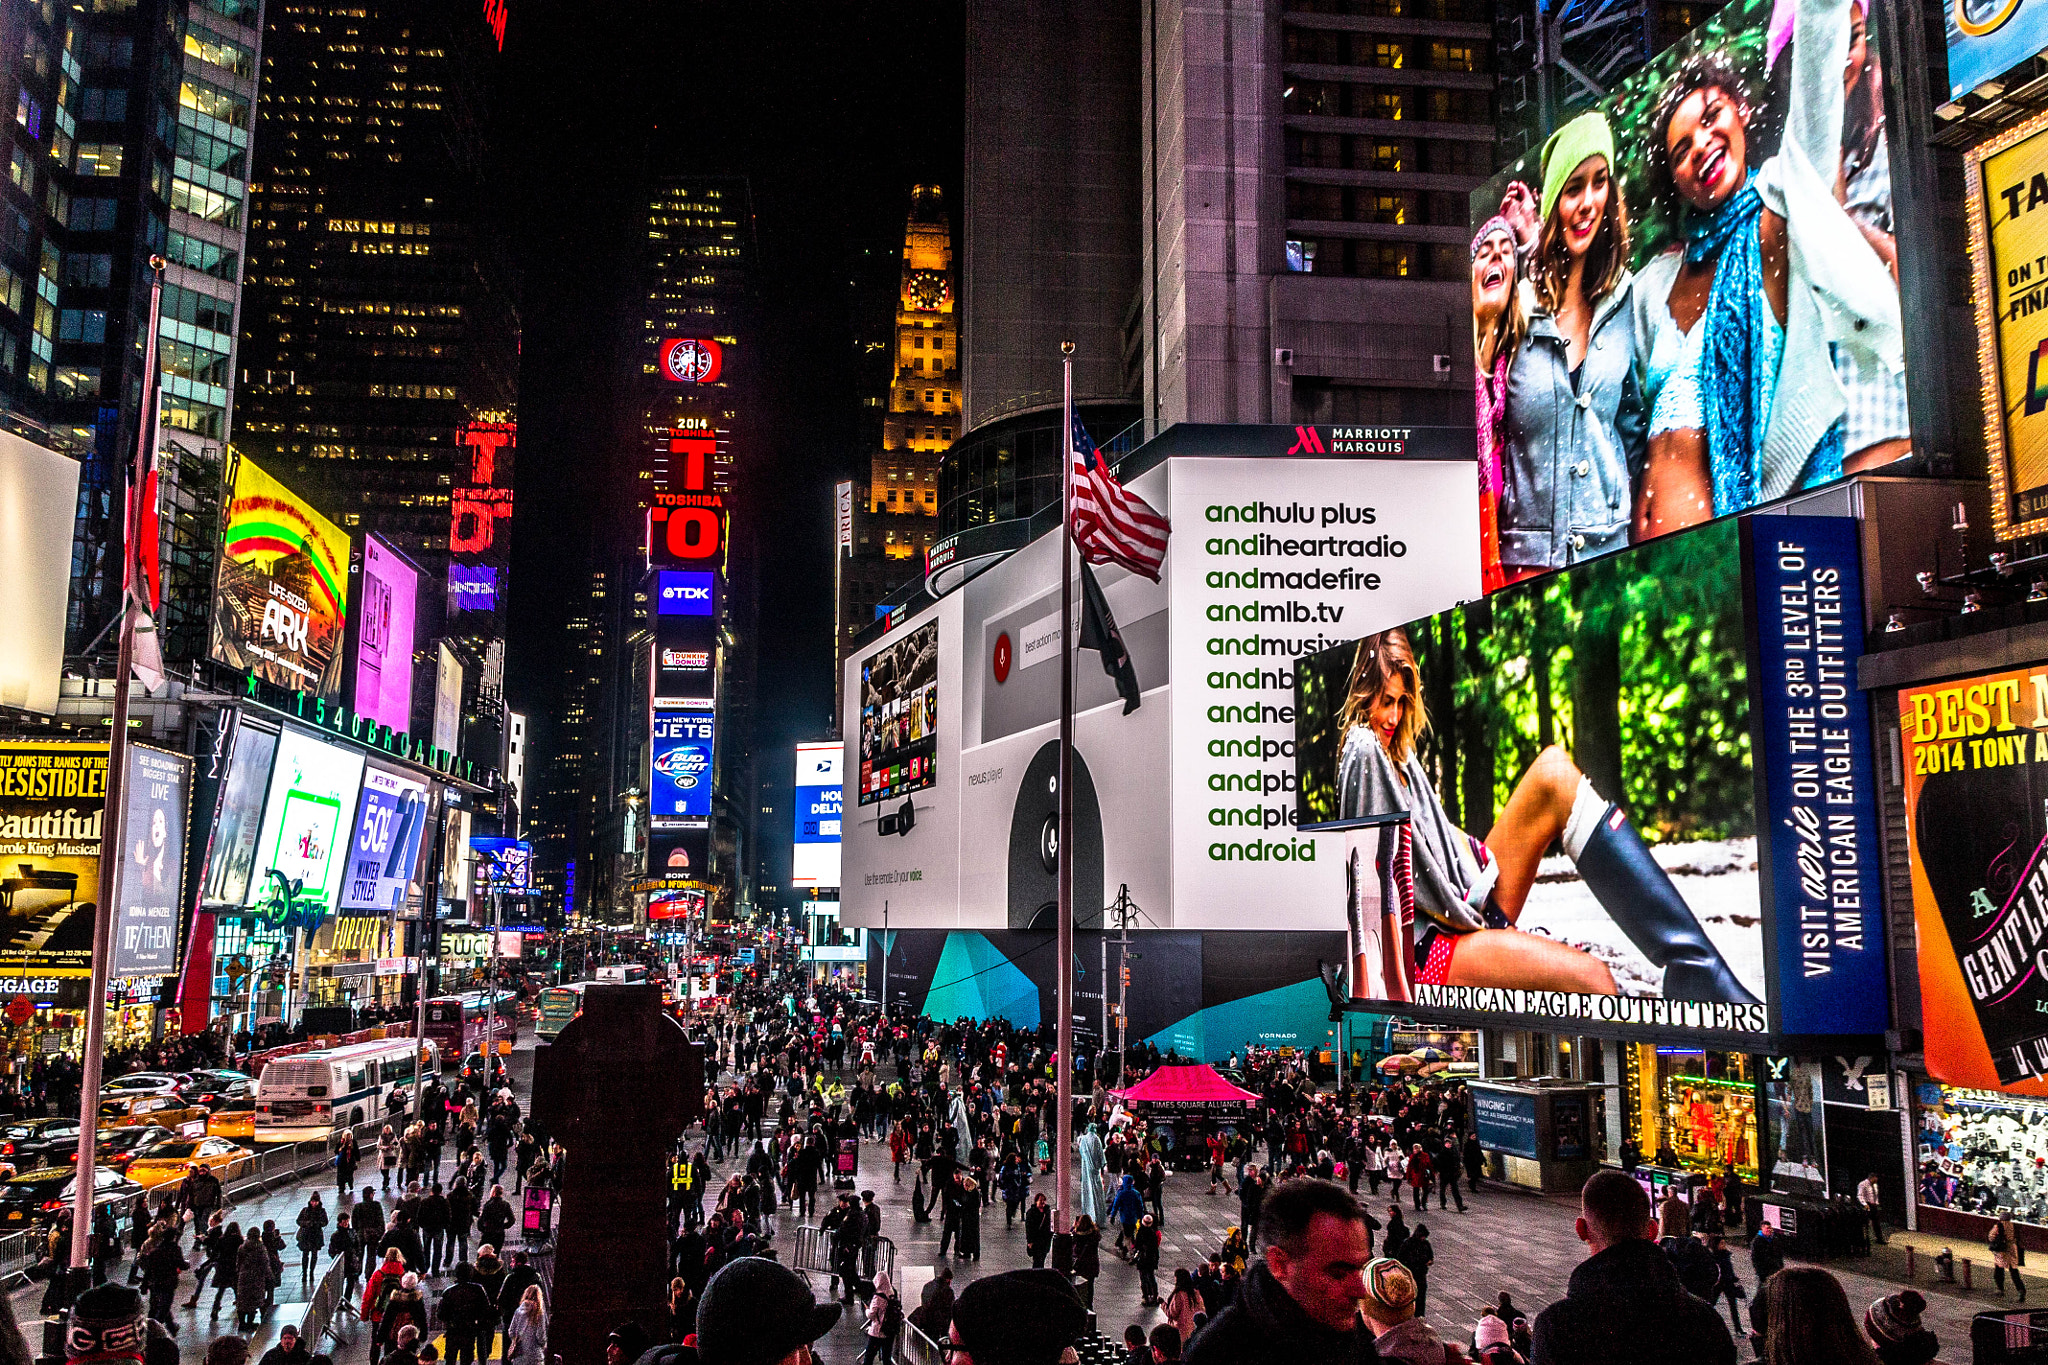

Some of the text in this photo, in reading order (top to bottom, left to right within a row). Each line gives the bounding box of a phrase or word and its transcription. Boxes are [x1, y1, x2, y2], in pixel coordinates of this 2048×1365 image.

[2008, 262, 2031, 287] ON
[670, 428, 715, 438] TOSHIBA
[677, 418, 708, 429] 2014
[1332, 428, 1411, 440] MARRIOTT
[1332, 441, 1403, 453] MARQUIS
[656, 494, 722, 507] TOSHIBA
[1205, 501, 1376, 528] andhulu plus
[1205, 534, 1407, 558] andiheartradio
[348, 565, 359, 573] G
[1205, 567, 1381, 591] andmadefire
[269, 580, 308, 613] LIFE-SIZED
[674, 588, 709, 599] TDK
[1206, 600, 1343, 623] andmlb.tv
[261, 599, 310, 657] ARK
[1025, 639, 1036, 654] best
[1036, 632, 1051, 649] action
[1910, 678, 2020, 744] BEST
[296, 691, 474, 782] 1540 BROADWAY
[655, 724, 712, 738] JETS
[13, 756, 37, 768] JOINS
[37, 756, 53, 768] THE
[54, 756, 81, 769] RANKS
[82, 757, 93, 768] OF
[93, 757, 109, 769] THE
[670, 753, 704, 762] BUD
[1778, 541, 1832, 978] VISIT aerie ON THE 3RD LEVEL OF
[1812, 567, 1864, 950] AMERICAN EAGLE OUTFITTERS
[1914, 731, 2048, 776] 2014 TONY A
[968, 766, 1004, 787] nexus player
[151, 782, 170, 801] LIVE
[27, 841, 55, 857] King
[56, 842, 101, 855] Musical
[1208, 837, 1316, 862] android
[356, 859, 380, 881] WINTER
[910, 867, 922, 882] voice
[351, 880, 377, 901] STYLES
[1969, 887, 1998, 918] A
[124, 921, 172, 953] IF/THEN
[331, 917, 381, 950] FOREVER
[1416, 984, 1766, 1032] AMERICAN EAGLE OUTFITTERS
[1152, 1100, 1241, 1109] TIMES SQUARE ALLIANCE
